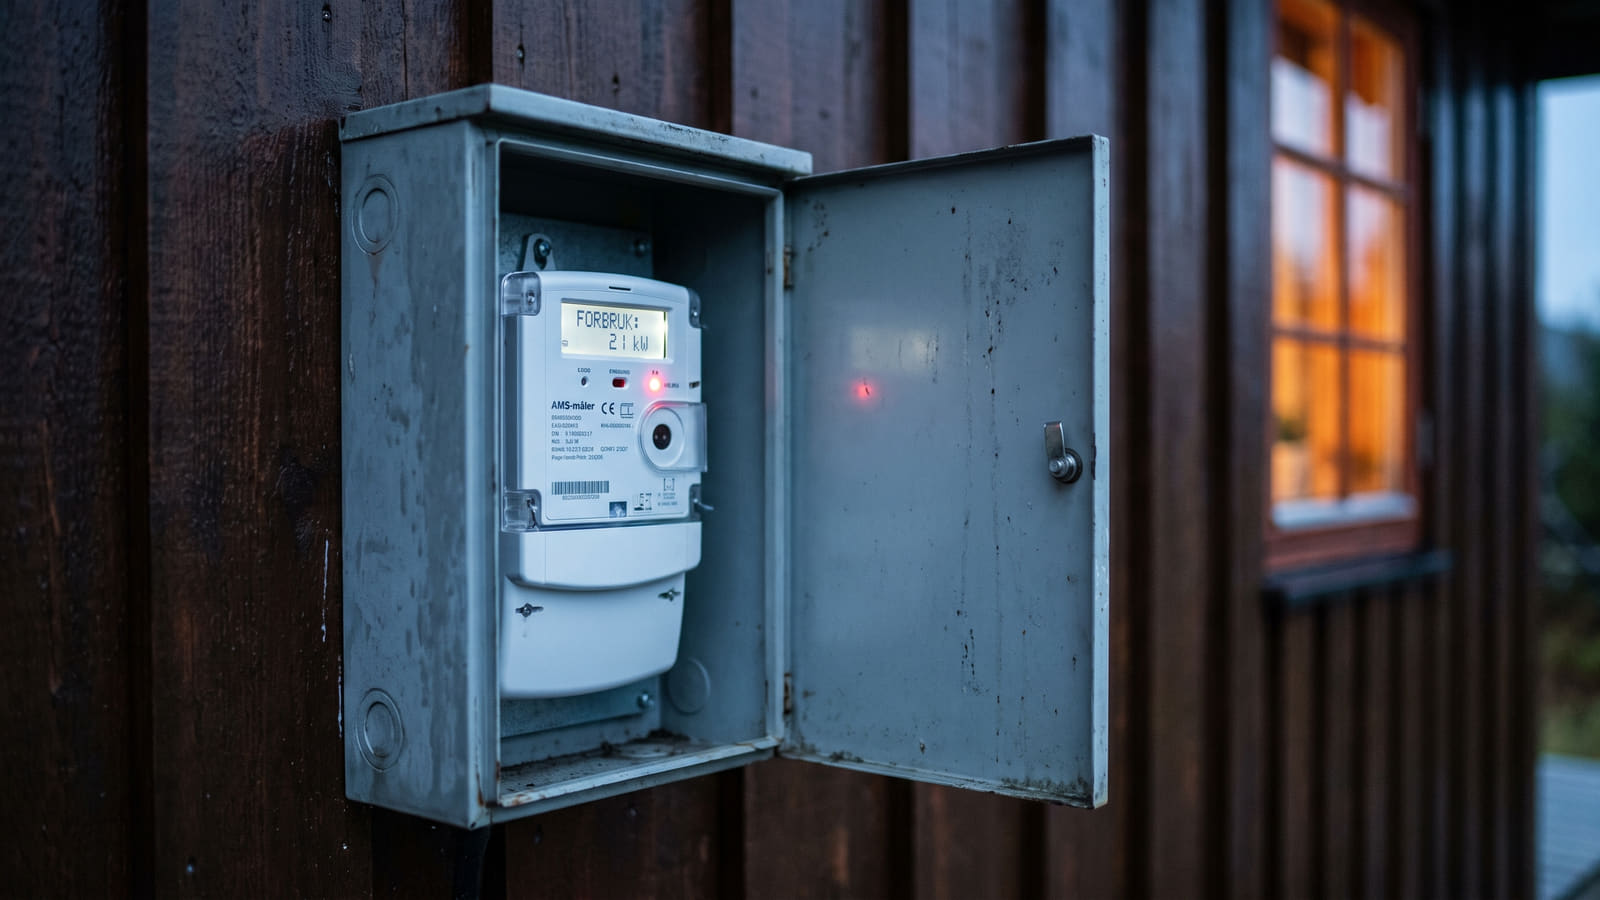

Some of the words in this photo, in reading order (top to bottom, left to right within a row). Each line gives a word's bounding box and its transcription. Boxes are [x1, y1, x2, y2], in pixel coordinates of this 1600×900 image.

[576, 309, 639, 330] FORBRUK:
[609, 333, 626, 350] 21
[633, 335, 649, 352] kW
[551, 400, 595, 410] AMS-måler
[601, 402, 615, 415] CE
